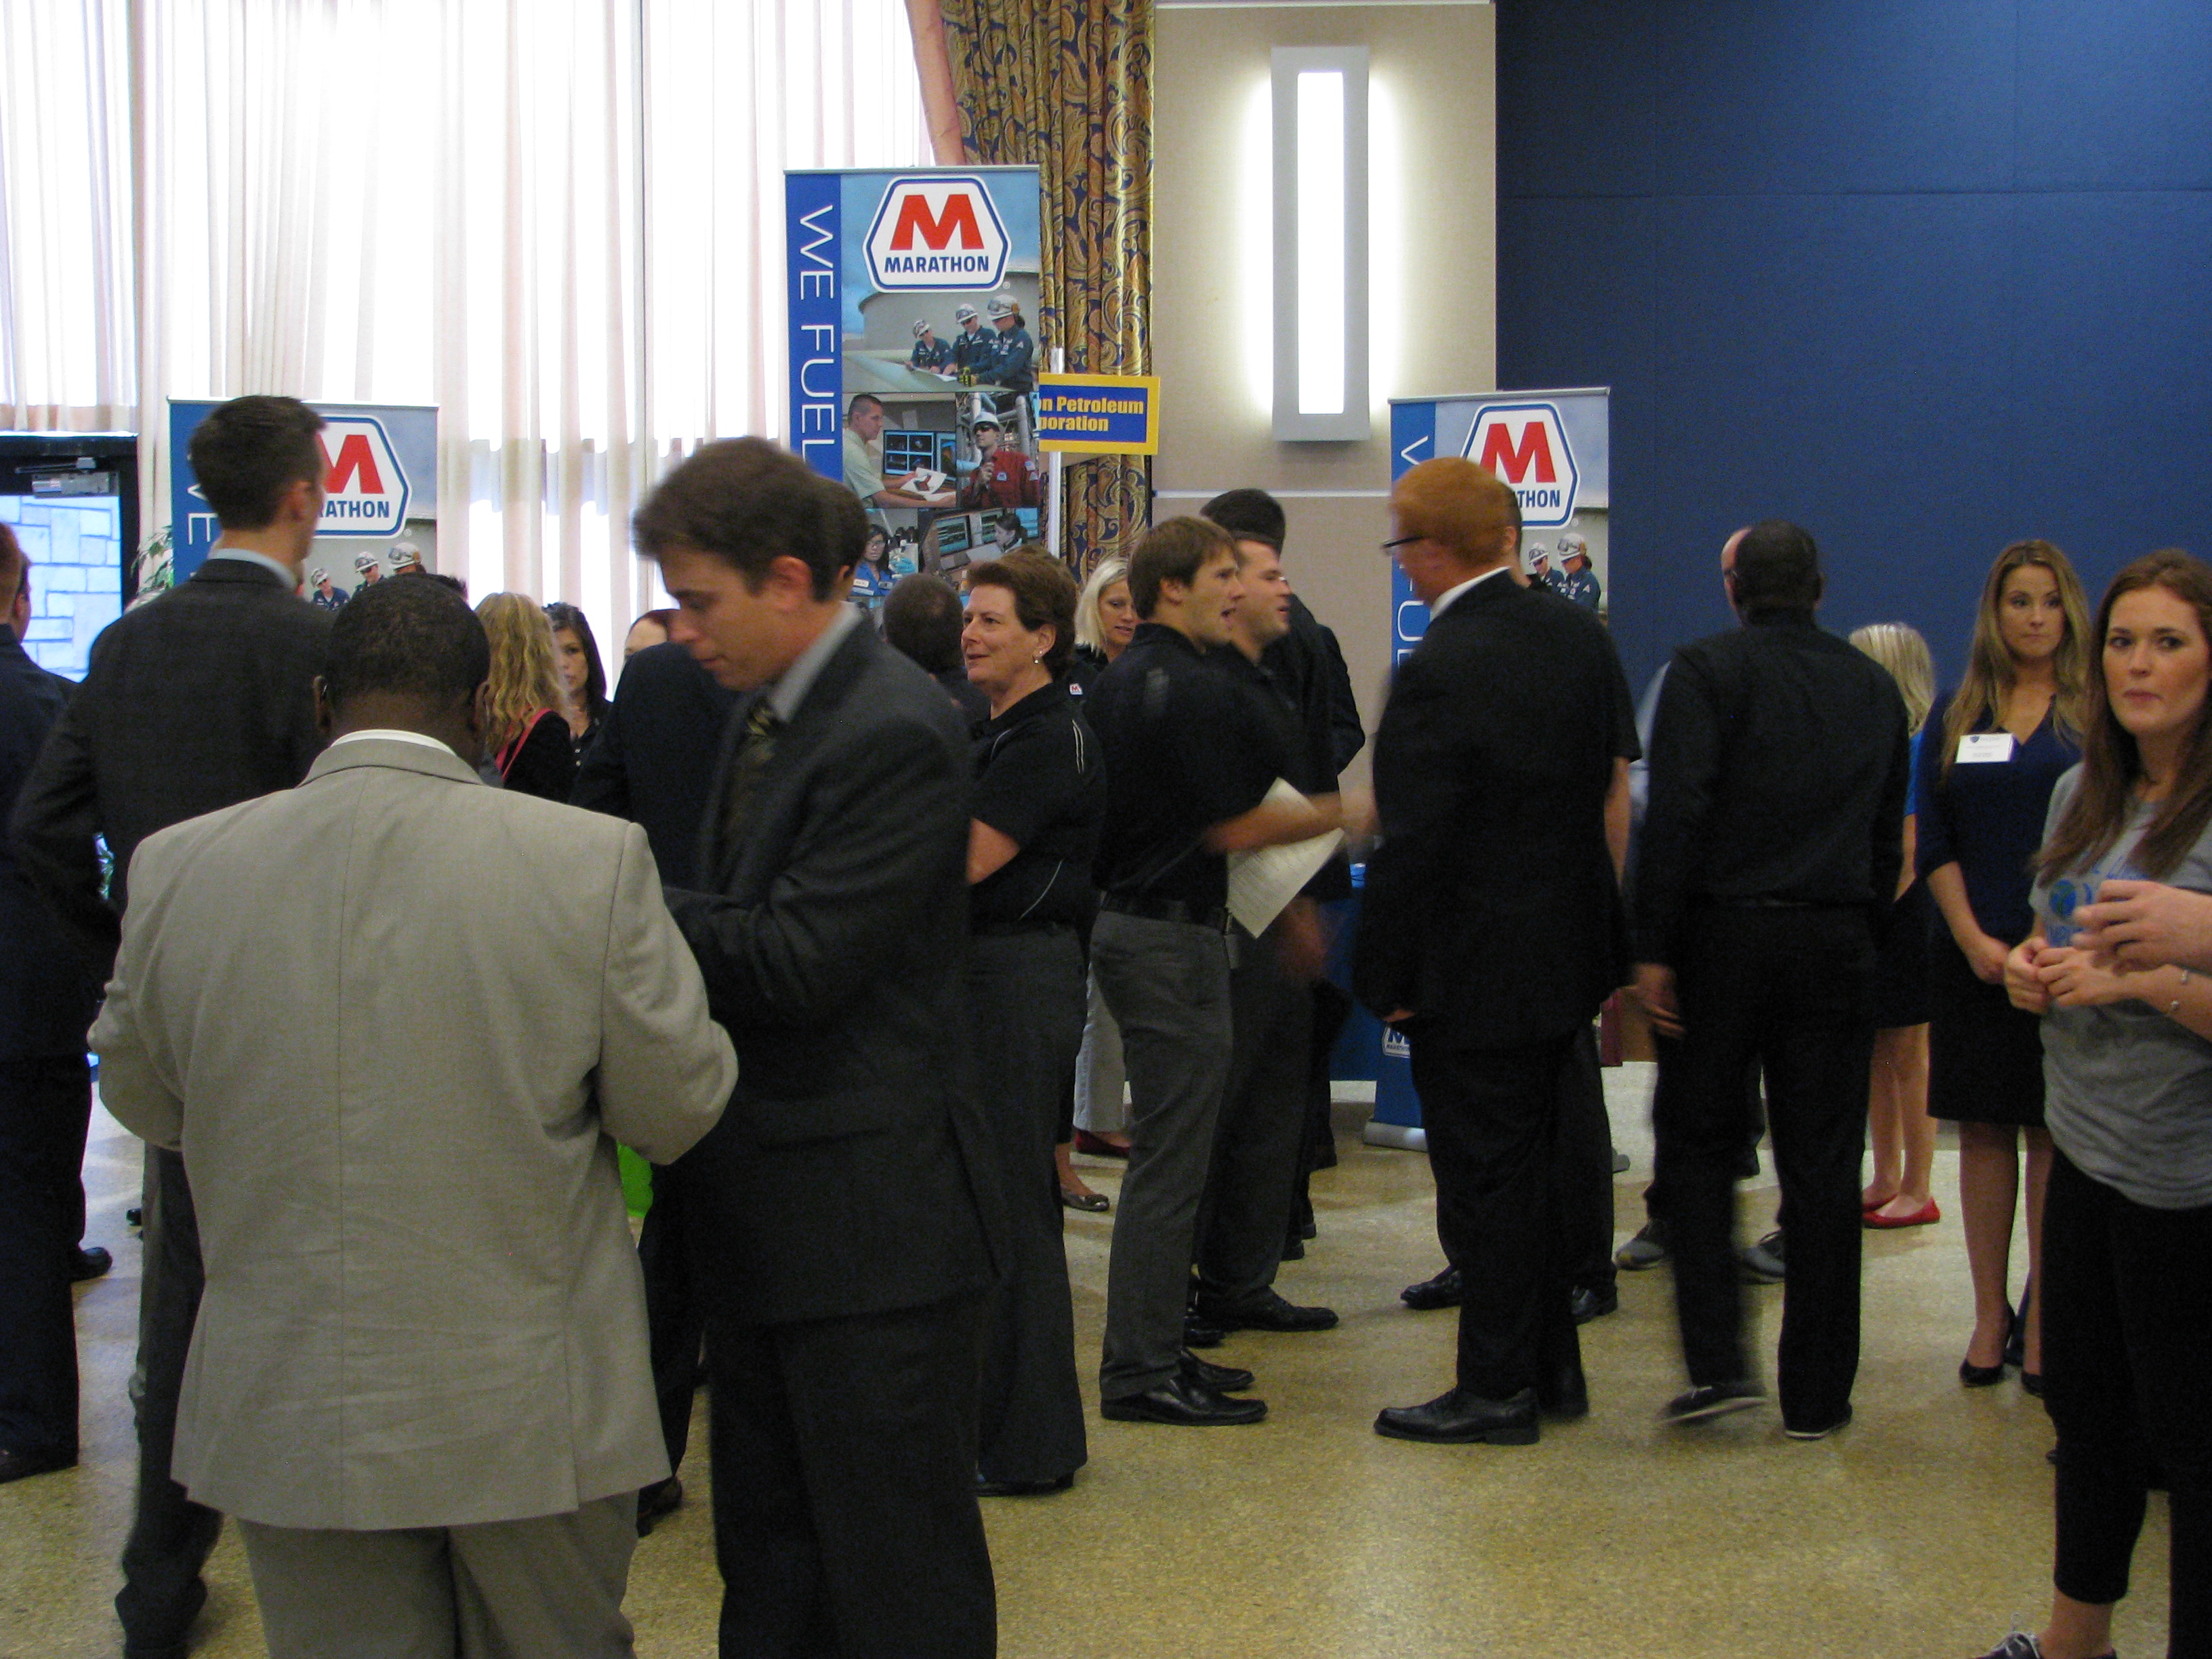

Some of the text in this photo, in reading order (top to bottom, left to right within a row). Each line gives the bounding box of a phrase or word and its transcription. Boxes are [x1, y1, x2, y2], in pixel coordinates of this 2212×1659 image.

[889, 194, 985, 250] M
[884, 255, 989, 272] MARATHON
[800, 205, 835, 463] WE FUEL
[1056, 396, 1144, 415] Petroleum
[1480, 422, 1557, 484] M
